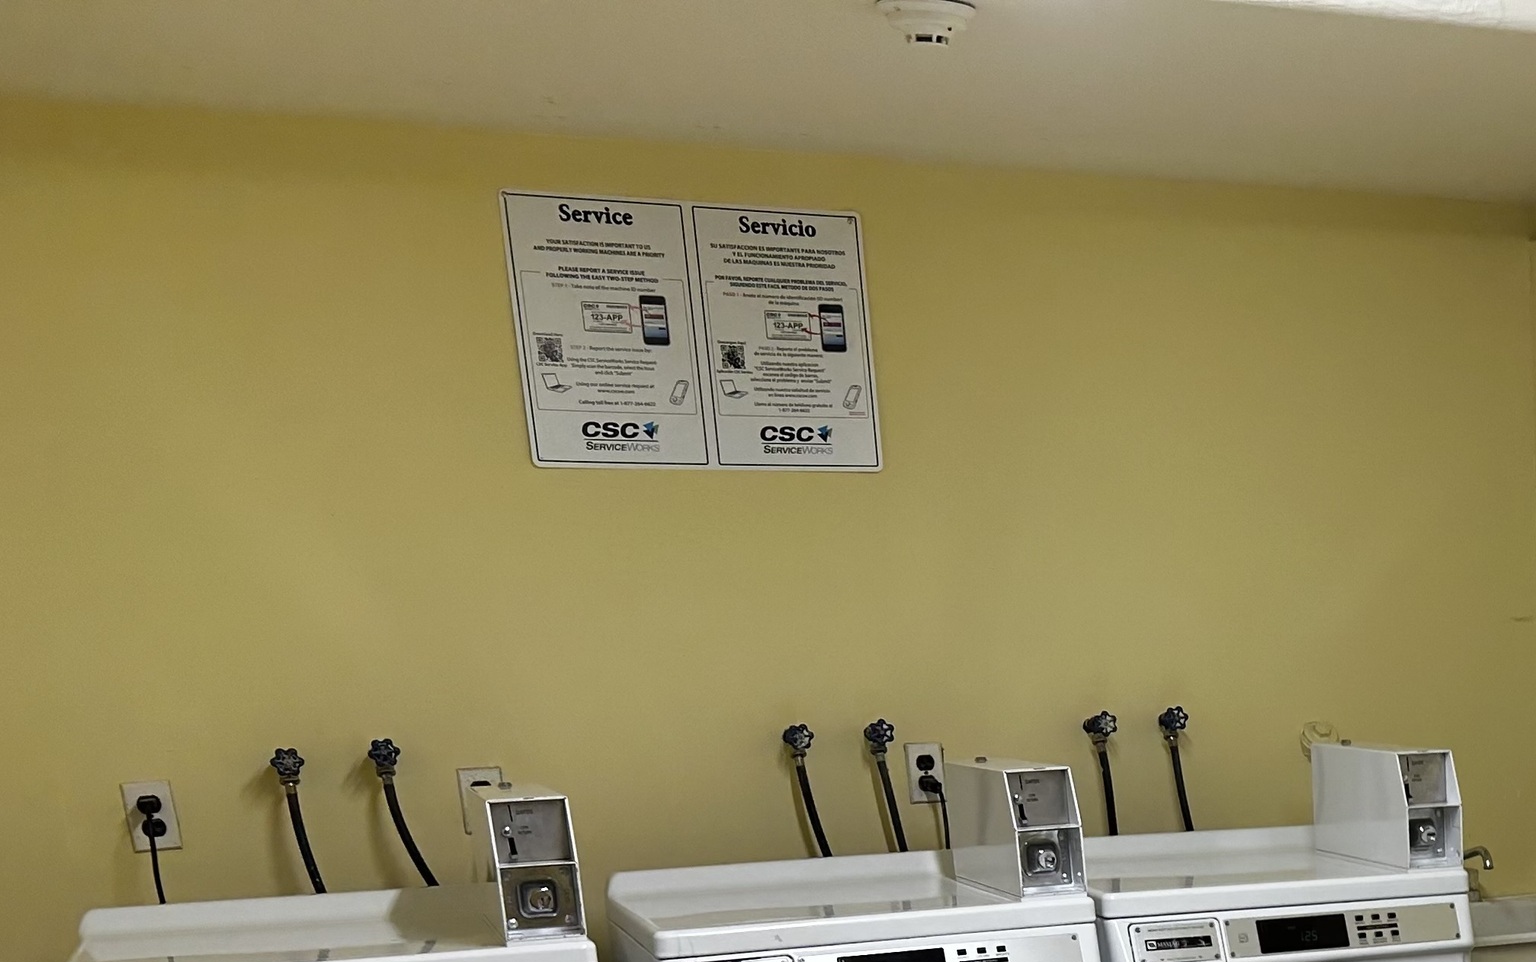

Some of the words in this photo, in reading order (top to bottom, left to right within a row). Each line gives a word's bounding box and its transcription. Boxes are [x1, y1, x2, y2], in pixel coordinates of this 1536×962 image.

[558, 204, 634, 225] Service
[738, 216, 816, 237] Servicio
[582, 422, 640, 438] CSC
[760, 426, 814, 442] CSC
